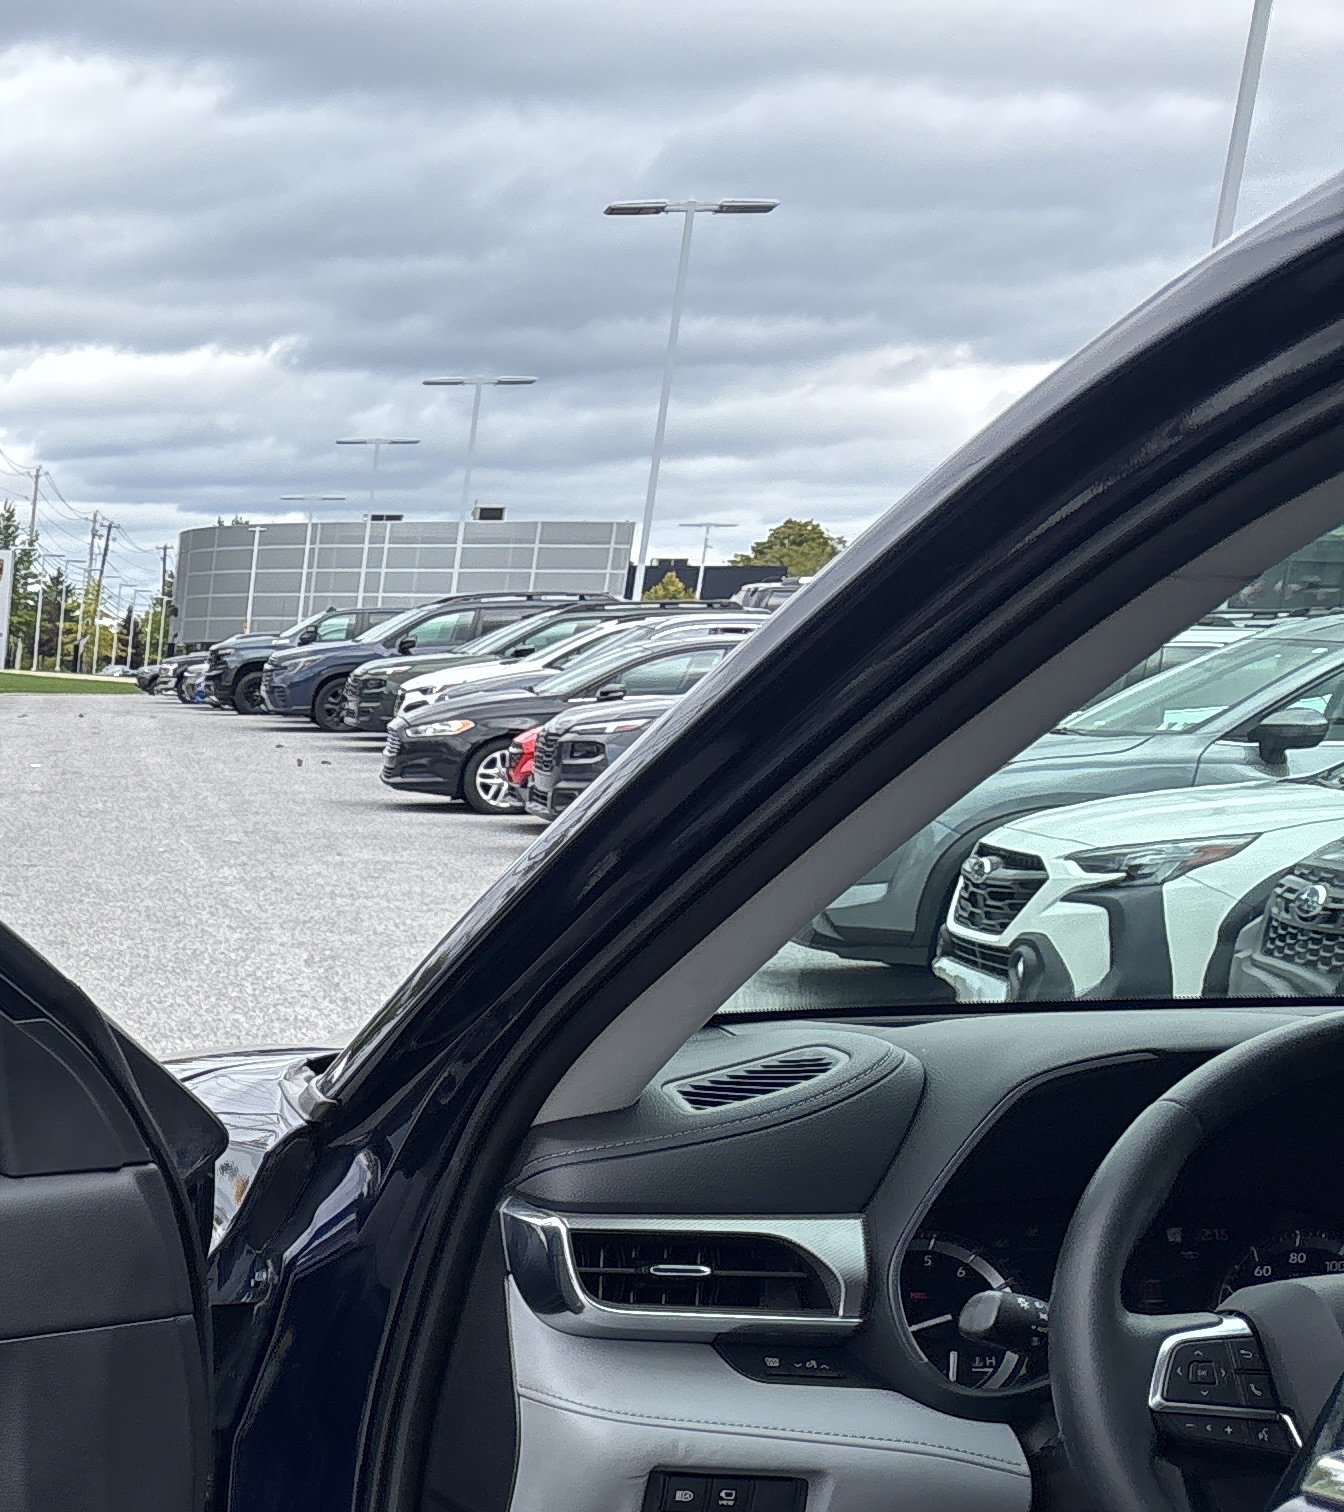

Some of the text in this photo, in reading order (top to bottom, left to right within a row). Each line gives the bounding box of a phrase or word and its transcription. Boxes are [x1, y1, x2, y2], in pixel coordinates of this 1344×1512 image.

[924, 1255, 932, 1266] 5
[1288, 1253, 1307, 1264] 80
[957, 1267, 965, 1278] 6
[1254, 1266, 1272, 1277] 60
